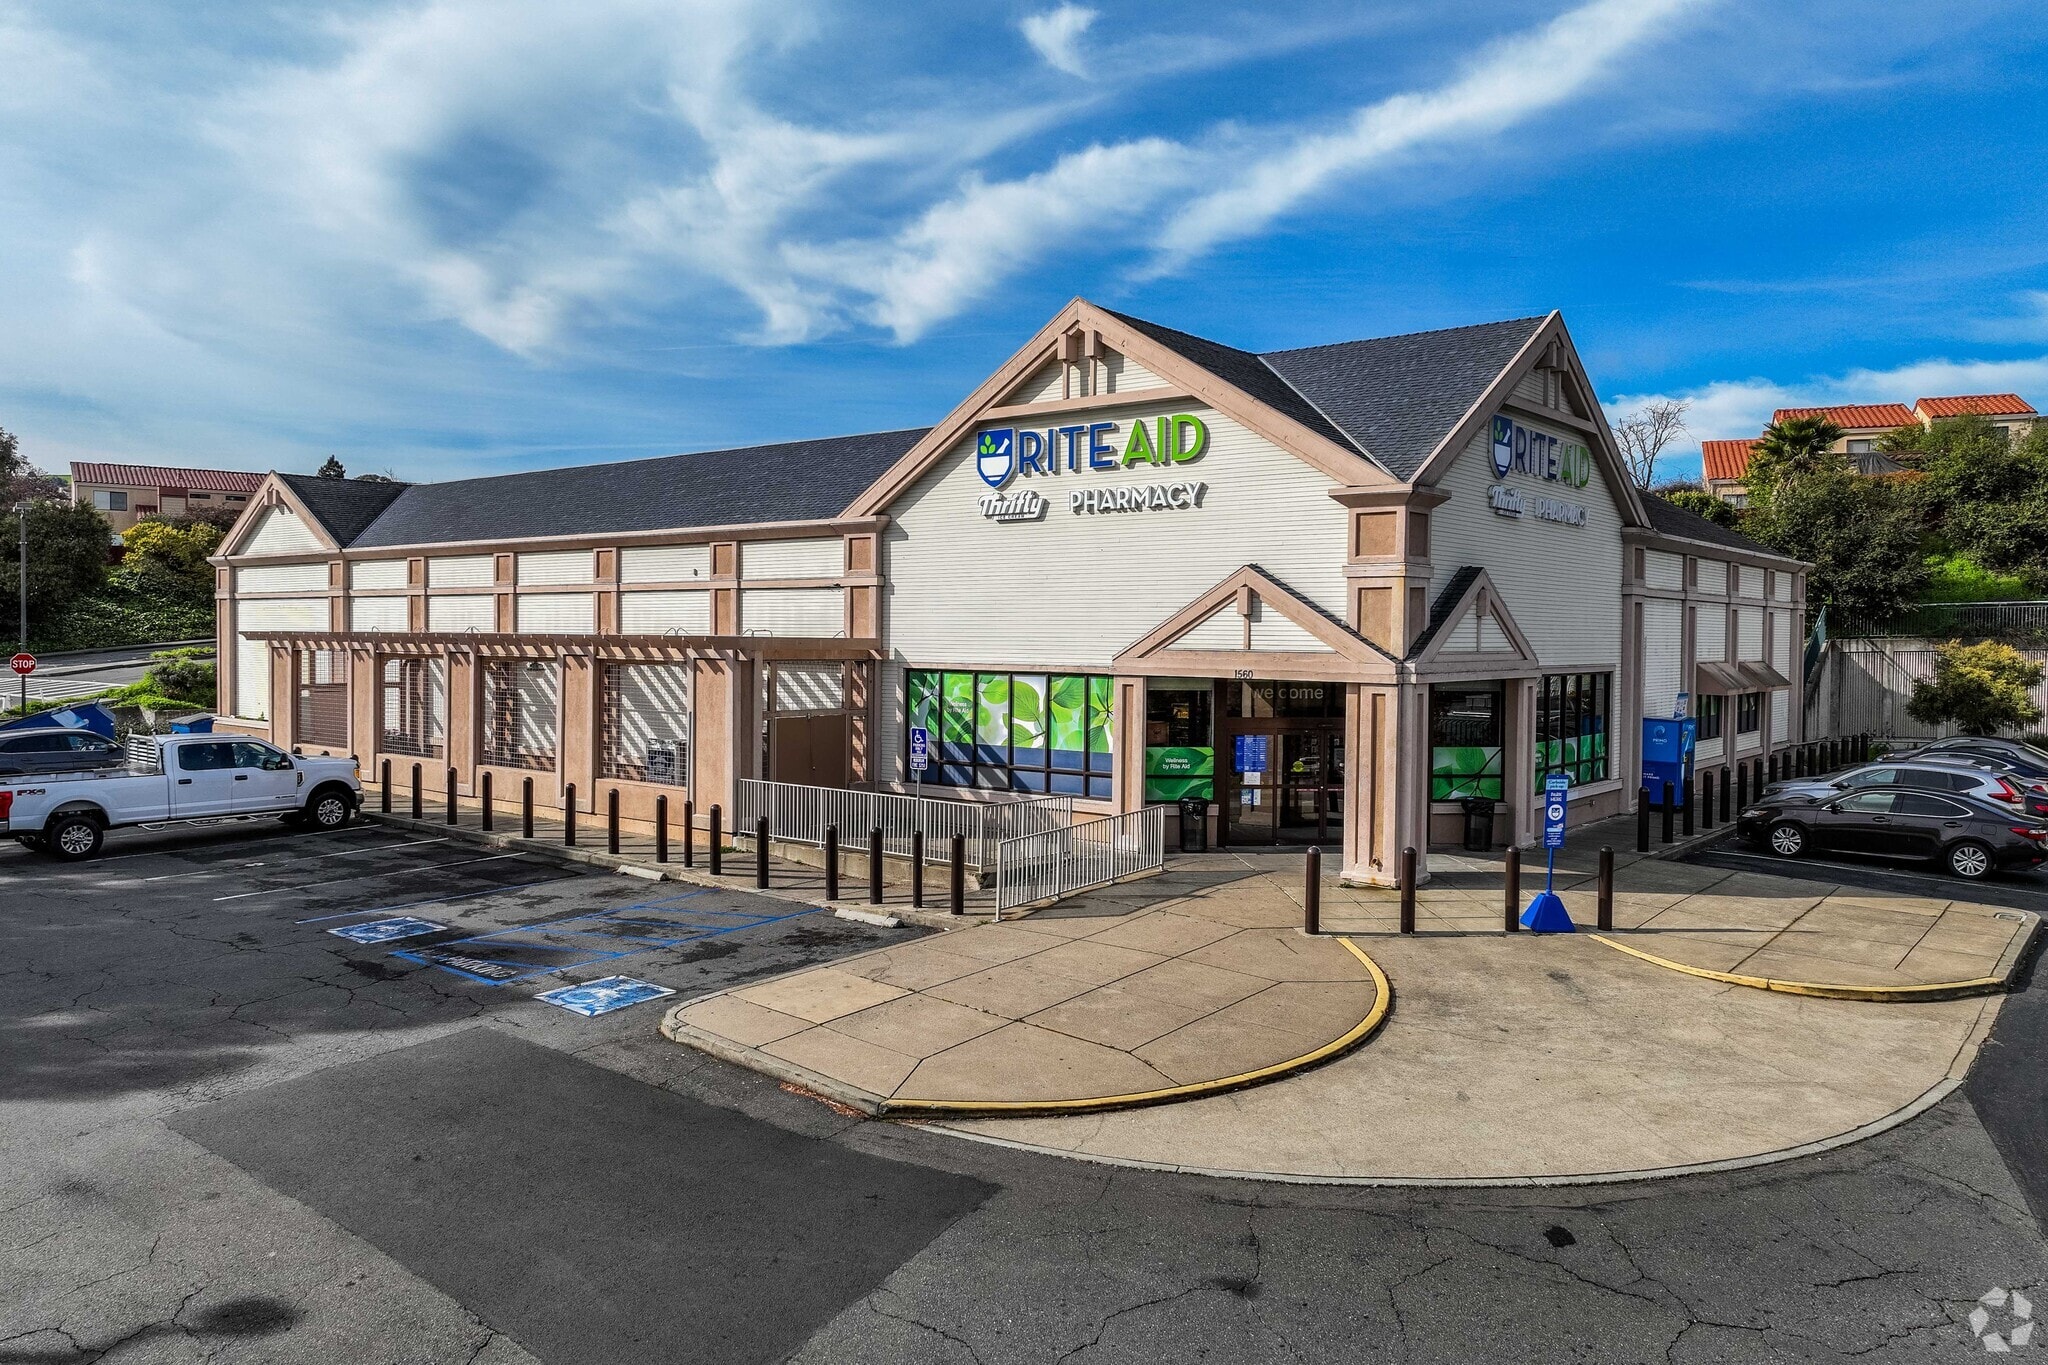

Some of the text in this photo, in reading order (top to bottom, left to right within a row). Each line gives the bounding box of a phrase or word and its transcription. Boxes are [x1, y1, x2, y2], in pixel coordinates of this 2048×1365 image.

[1018, 413, 1206, 474] RITE AID
[1514, 425, 1590, 488] RITE AID
[977, 481, 1202, 518] Thrifty PHARMACY
[1536, 498, 1590, 526] PHARMACY
[12, 659, 35, 669] STOP
[1234, 669, 1254, 680] 1560
[1252, 688, 1324, 699] wecome
[17, 788, 46, 796] FX4
